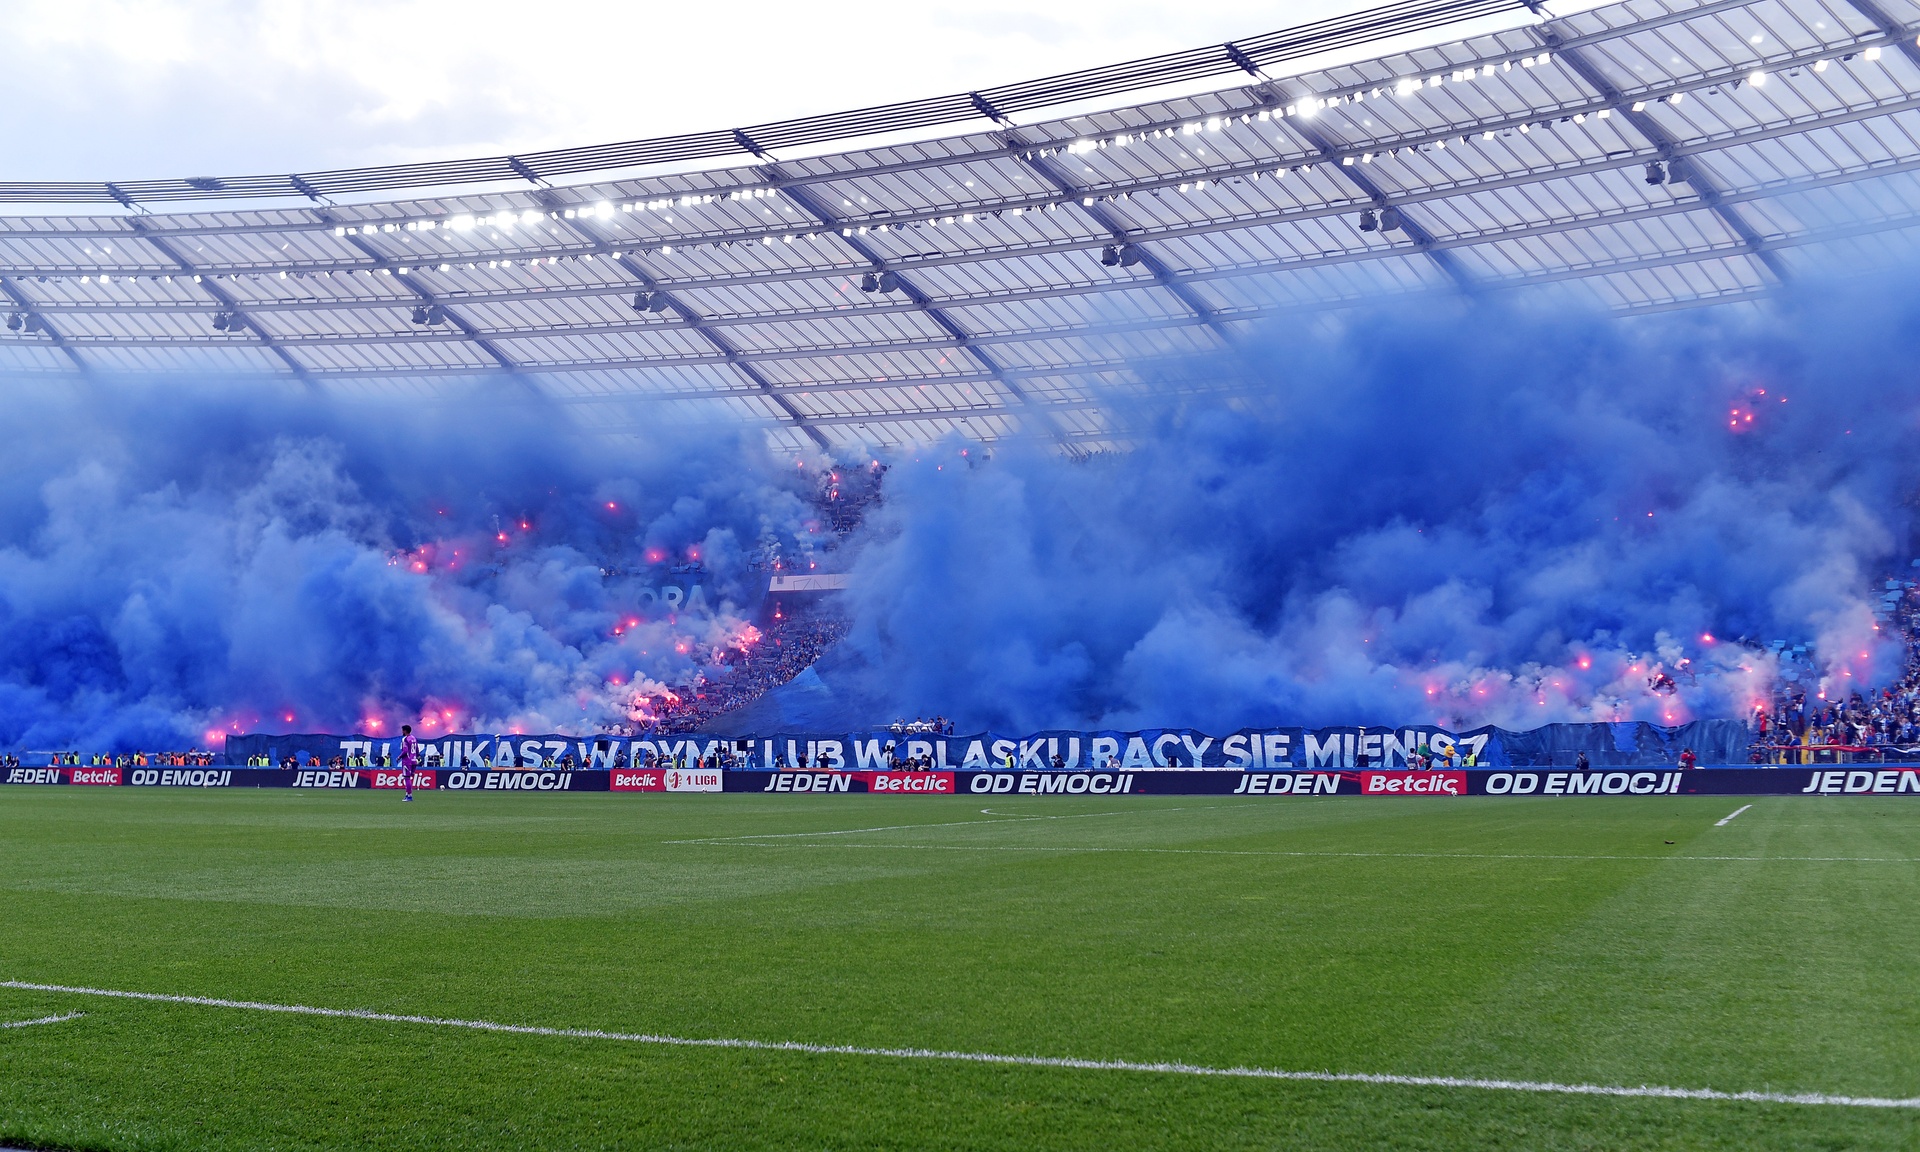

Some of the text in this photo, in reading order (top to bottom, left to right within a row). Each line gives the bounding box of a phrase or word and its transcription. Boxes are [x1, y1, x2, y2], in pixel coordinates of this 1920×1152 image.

[340, 741, 391, 768] TU
[577, 742, 620, 768] W
[764, 739, 845, 768] LUB
[854, 739, 896, 768] W
[907, 738, 1077, 768] BLASKU
[1092, 734, 1214, 768] RACY
[1222, 734, 1293, 768] SIE
[6, 768, 232, 787] JEDEN Betclic OD EMOCJI
[292, 771, 572, 790] JEDEN Betlic OD EMOCJI
[615, 773, 657, 788] Betclic
[695, 775, 717, 785] LIGA
[764, 773, 1134, 794] JEDEN Betclic OD EMOCJI
[1233, 772, 1683, 794] JEDEN Betclic OD EMOCJI
